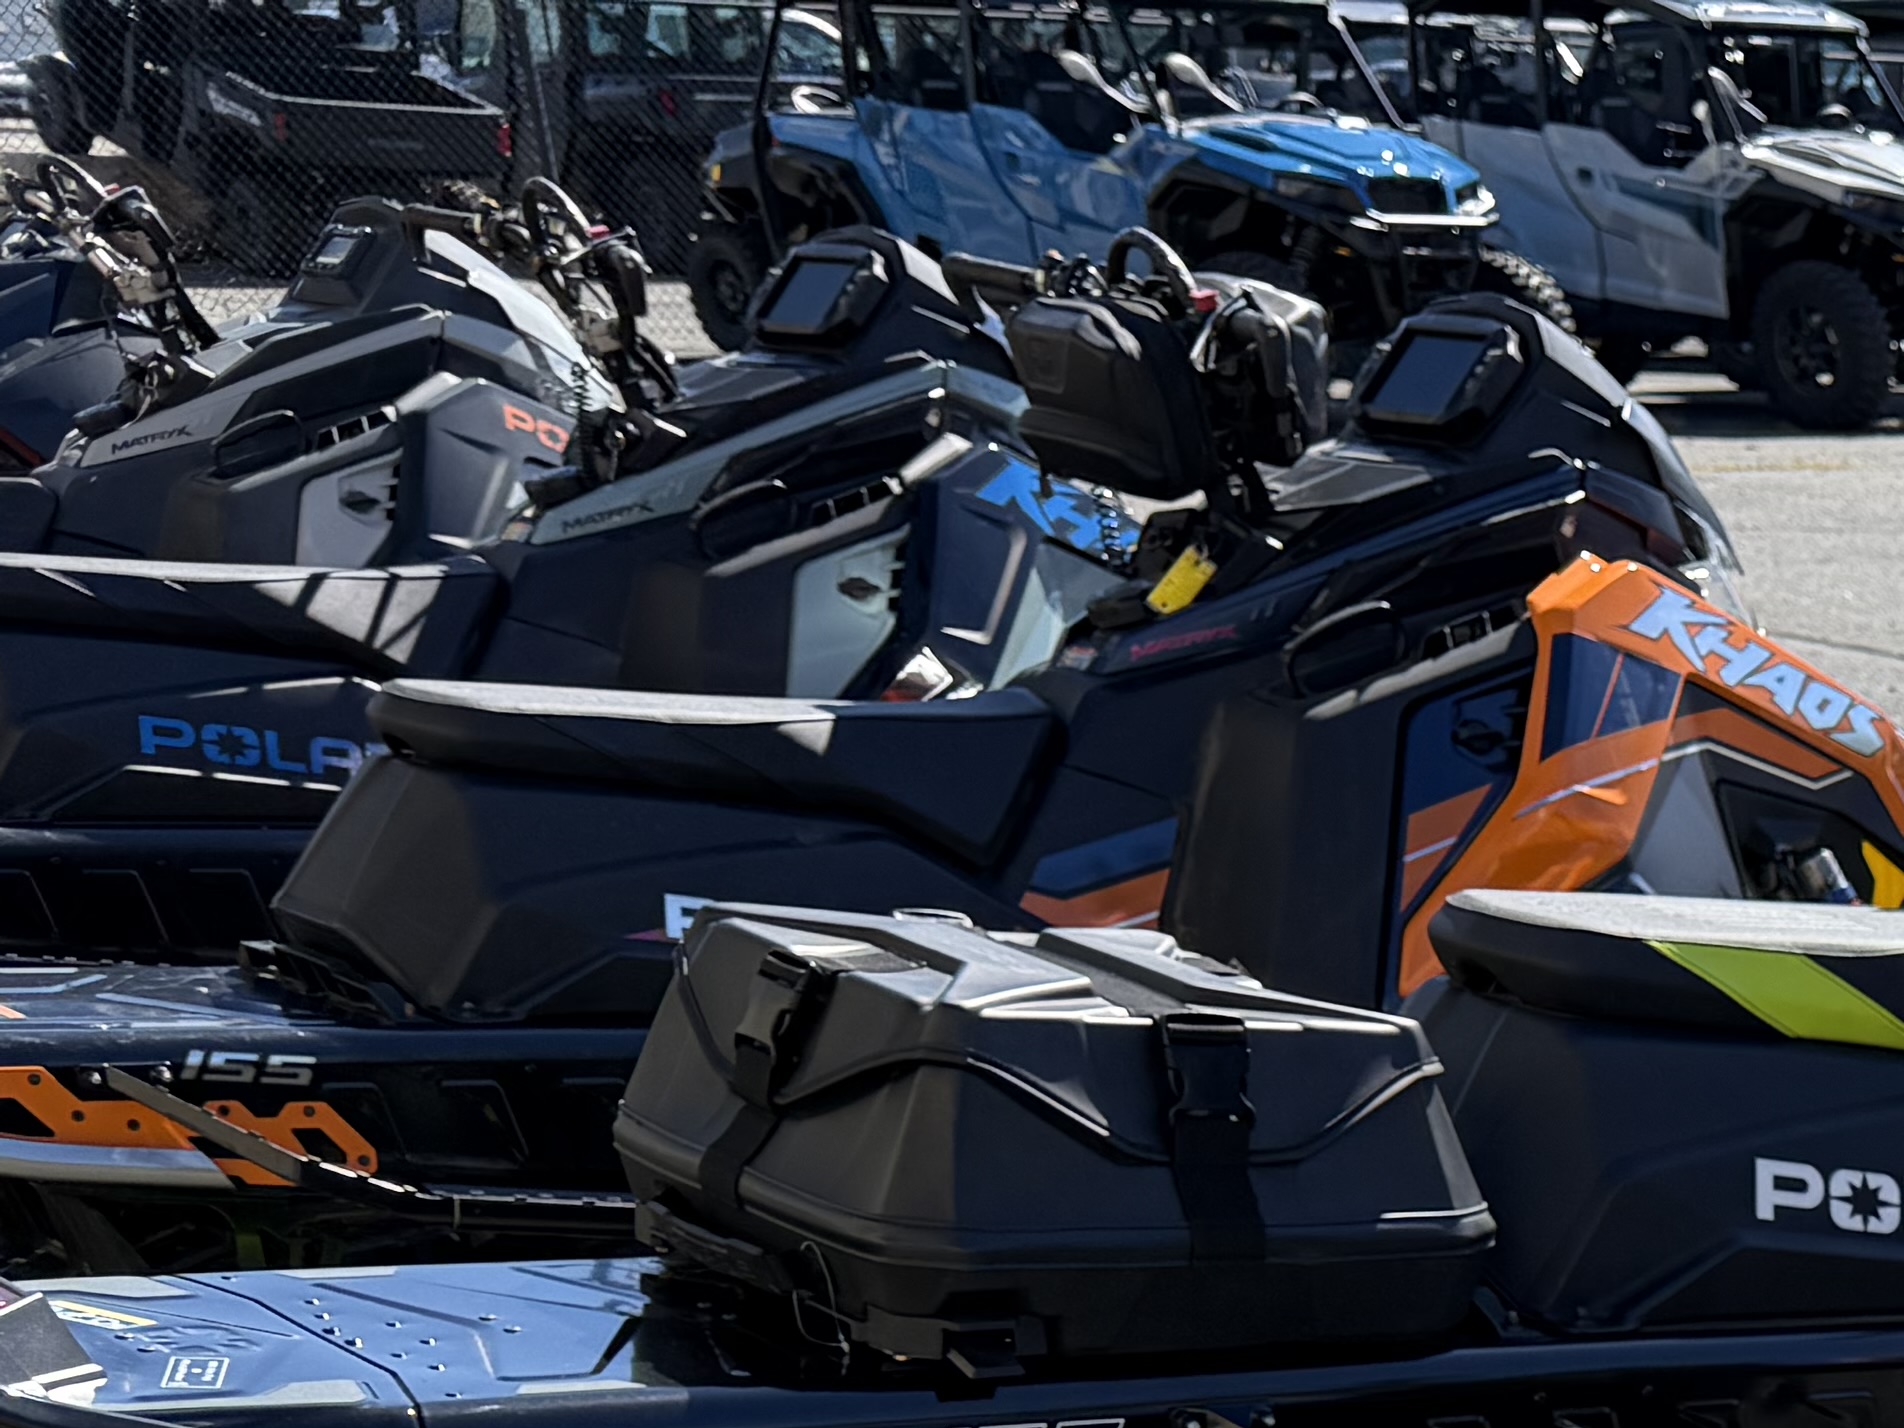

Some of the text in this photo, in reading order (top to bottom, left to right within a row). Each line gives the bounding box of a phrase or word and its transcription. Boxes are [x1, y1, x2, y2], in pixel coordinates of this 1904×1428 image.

[111, 424, 194, 455] MATRYX
[1624, 583, 1884, 757] KHAOS
[181, 1050, 317, 1086] 155
